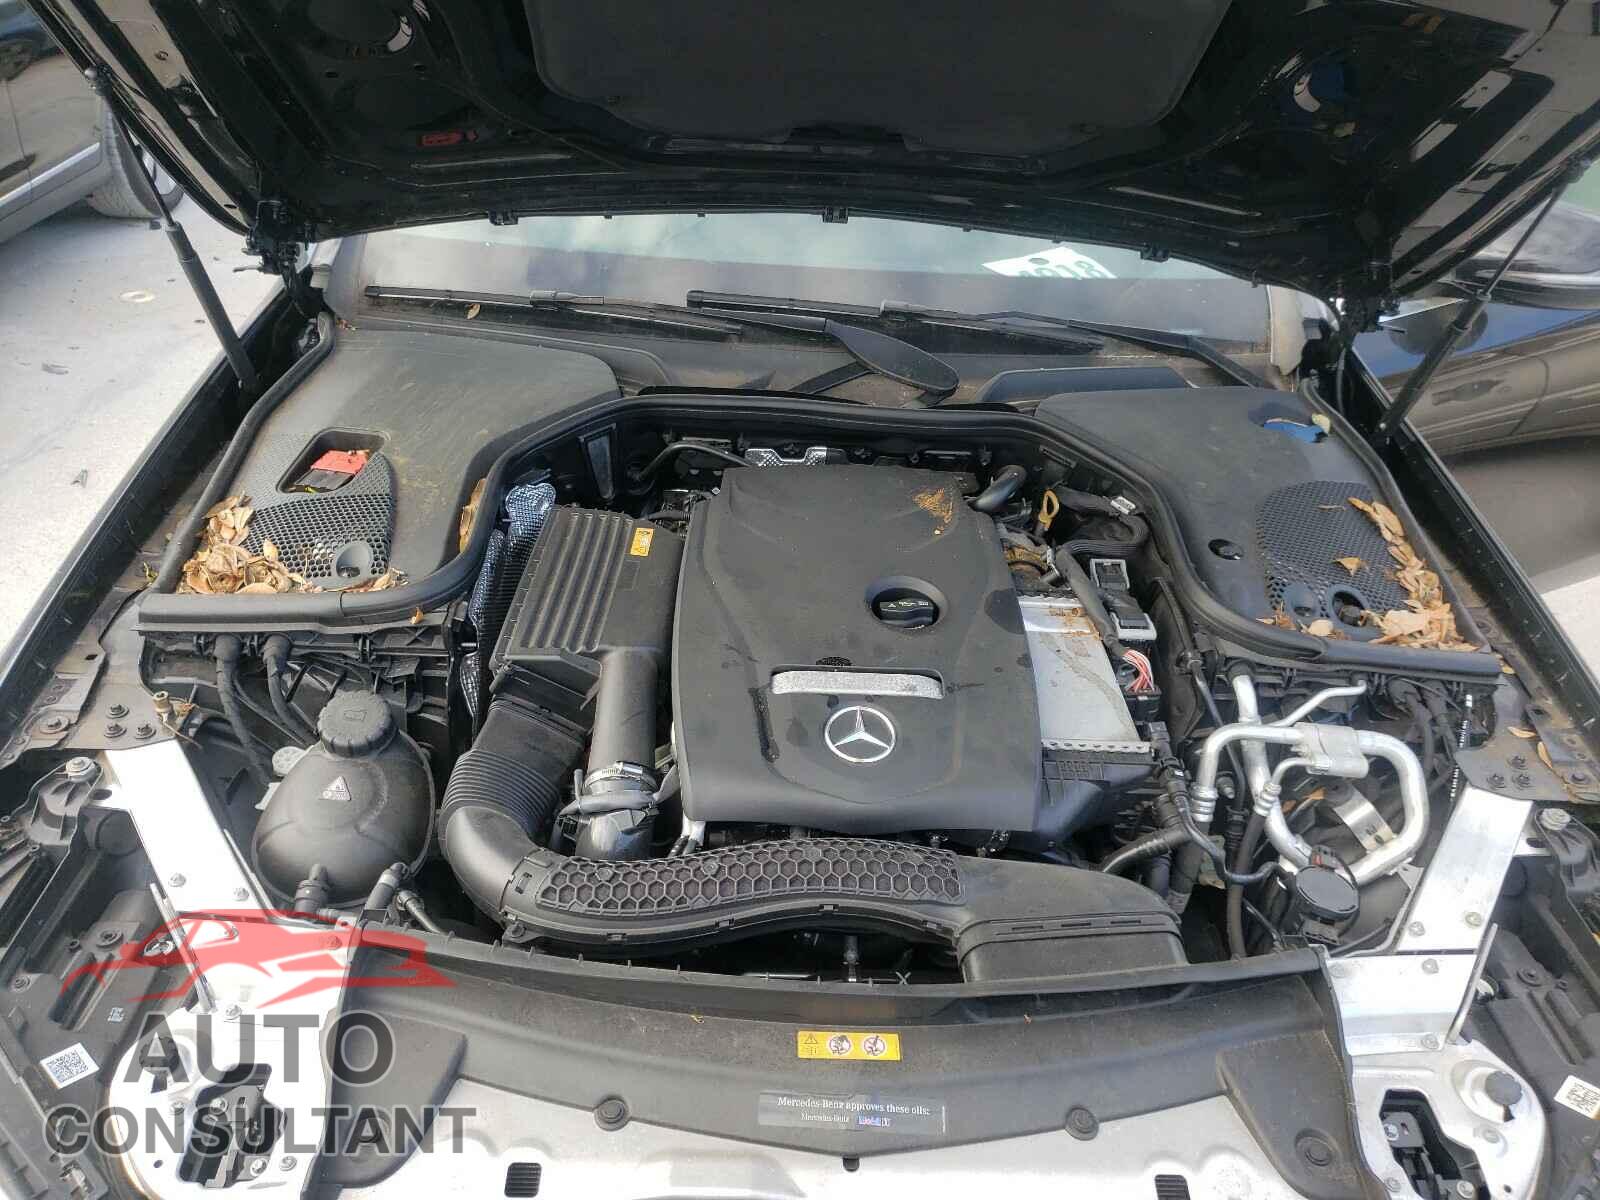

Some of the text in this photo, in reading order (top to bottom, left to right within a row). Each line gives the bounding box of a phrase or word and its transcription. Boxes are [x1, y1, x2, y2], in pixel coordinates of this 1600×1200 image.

[777, 1096, 844, 1109] Mercedes-Benz
[846, 1101, 885, 1113] approves
[886, 1103, 910, 1114] these
